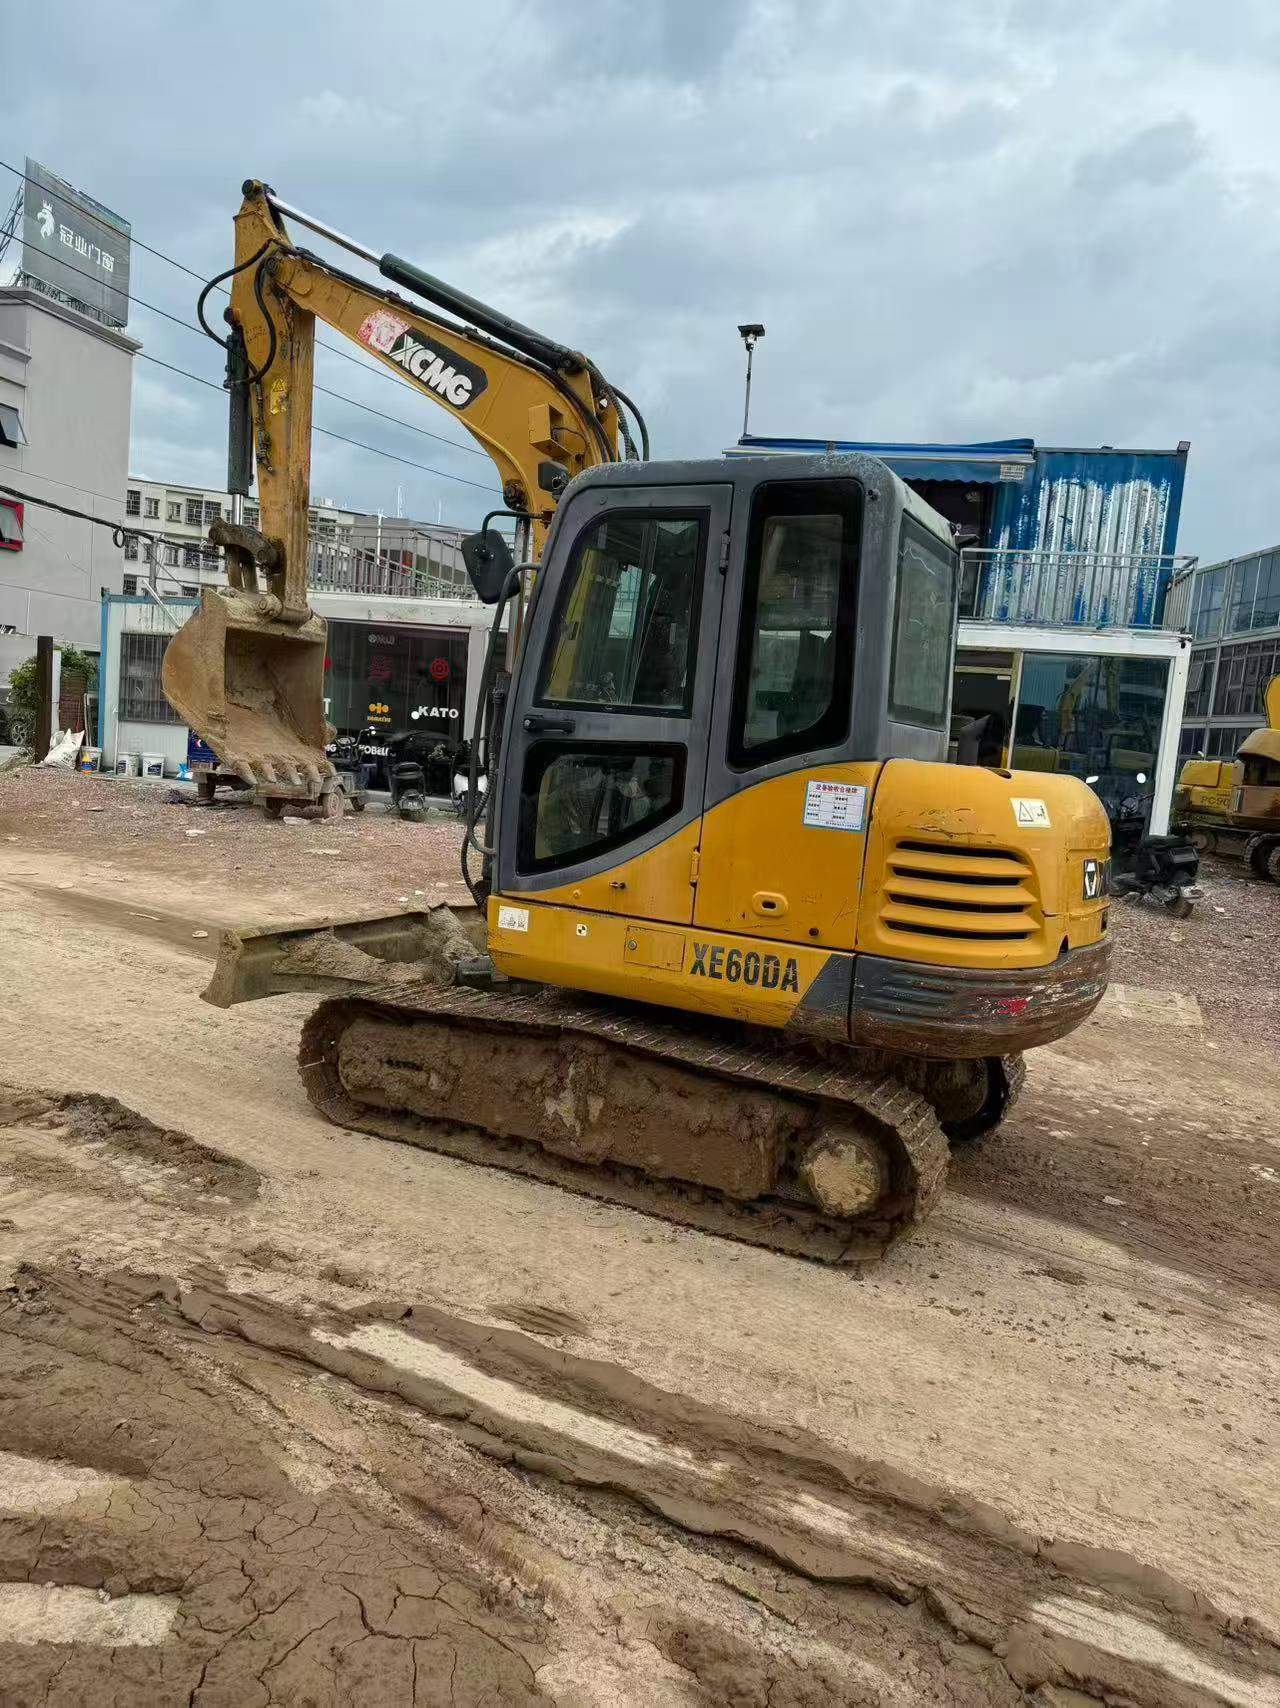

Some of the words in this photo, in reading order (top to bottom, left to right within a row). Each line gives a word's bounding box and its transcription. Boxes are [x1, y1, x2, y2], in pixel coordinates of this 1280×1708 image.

[389, 333, 473, 405] XCMG
[418, 705, 459, 719] KATO
[690, 941, 799, 993] XE60DA
